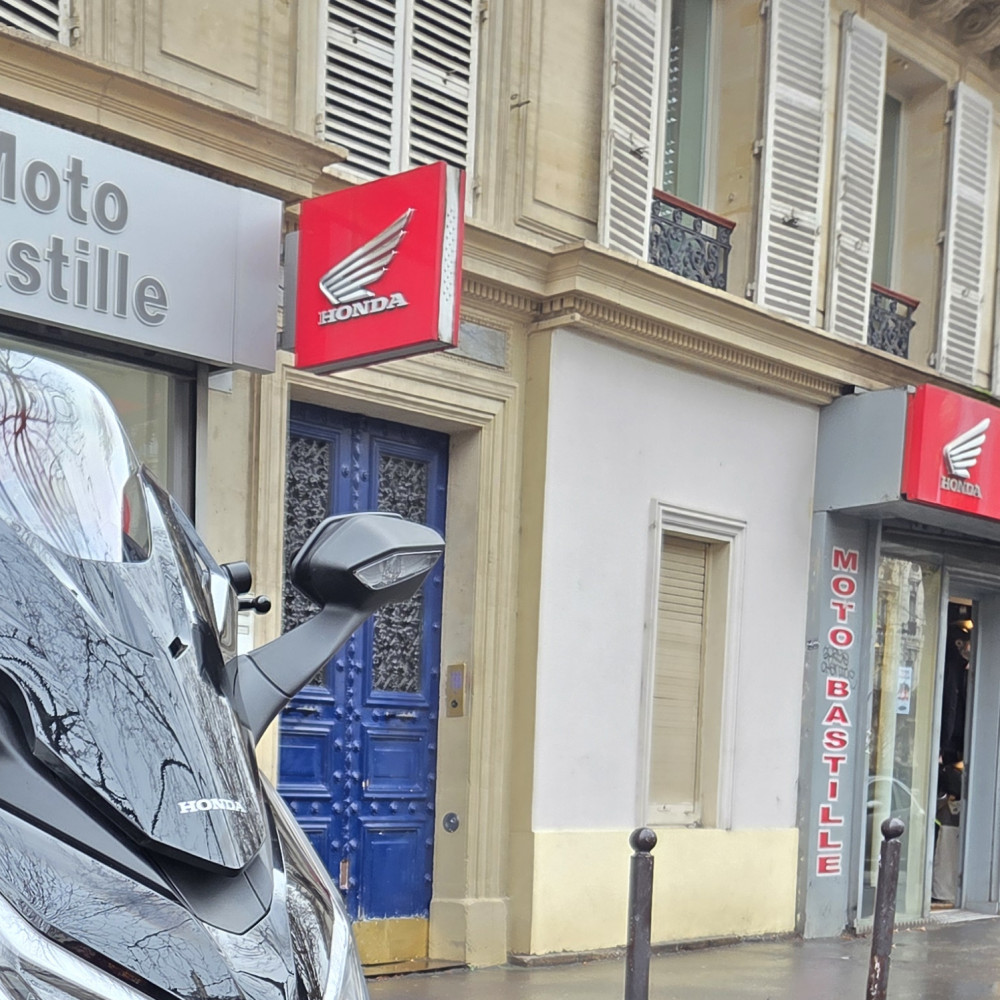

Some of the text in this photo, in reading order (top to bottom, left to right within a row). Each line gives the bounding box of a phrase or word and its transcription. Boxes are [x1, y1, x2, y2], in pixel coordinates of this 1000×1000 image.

[318, 292, 409, 325] HONDA
[941, 475, 983, 499] HONDA
[829, 547, 859, 649] MOTO
[816, 677, 851, 876] BASTILLE
[178, 798, 247, 813] HONDA
